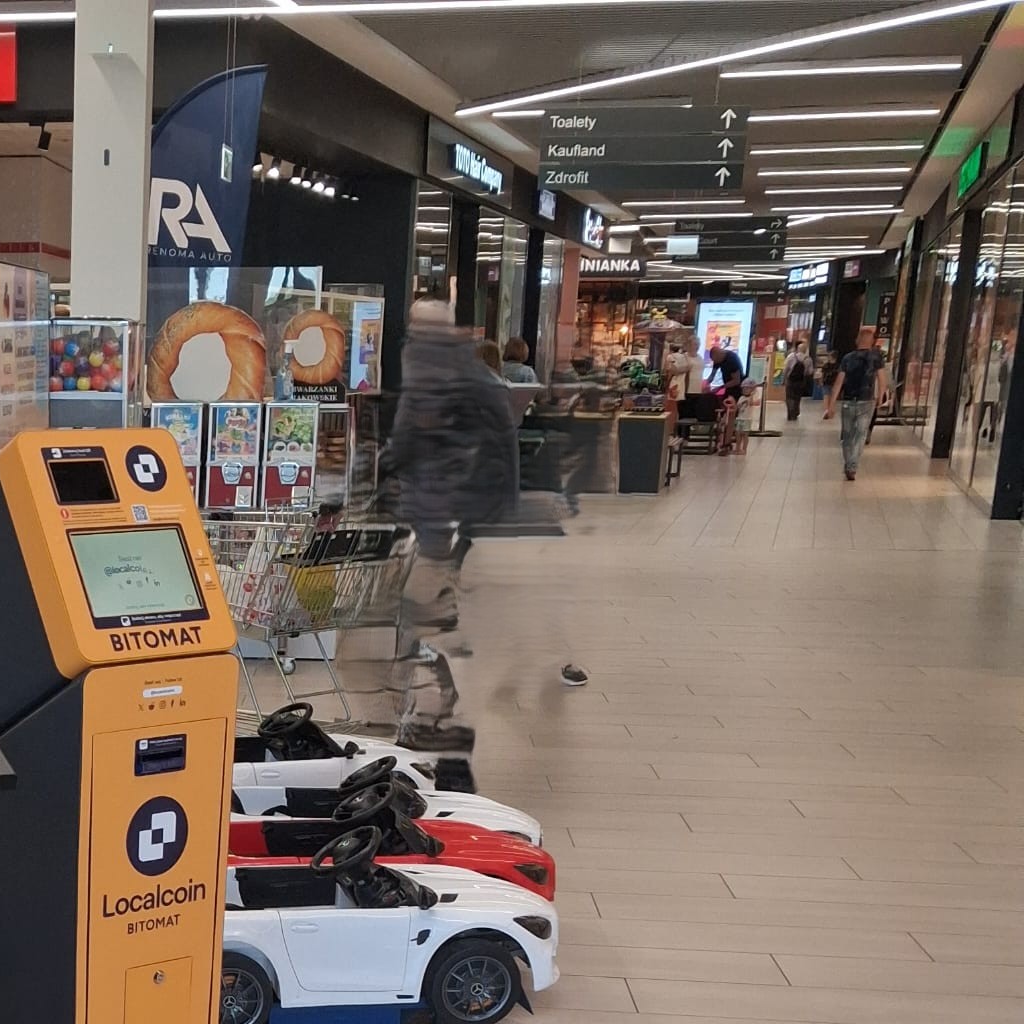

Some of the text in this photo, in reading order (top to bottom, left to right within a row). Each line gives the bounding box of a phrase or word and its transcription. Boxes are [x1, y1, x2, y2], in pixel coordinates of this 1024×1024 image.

[550, 116, 596, 130] Toalety
[548, 144, 605, 157] Kaufland
[545, 171, 589, 184] Zdrofit
[148, 178, 232, 253] RA
[200, 251, 232, 262] AUTO
[109, 626, 201, 652] BITOMAT
[102, 878, 206, 918] Localcoin
[127, 913, 181, 935] BITOMAT
